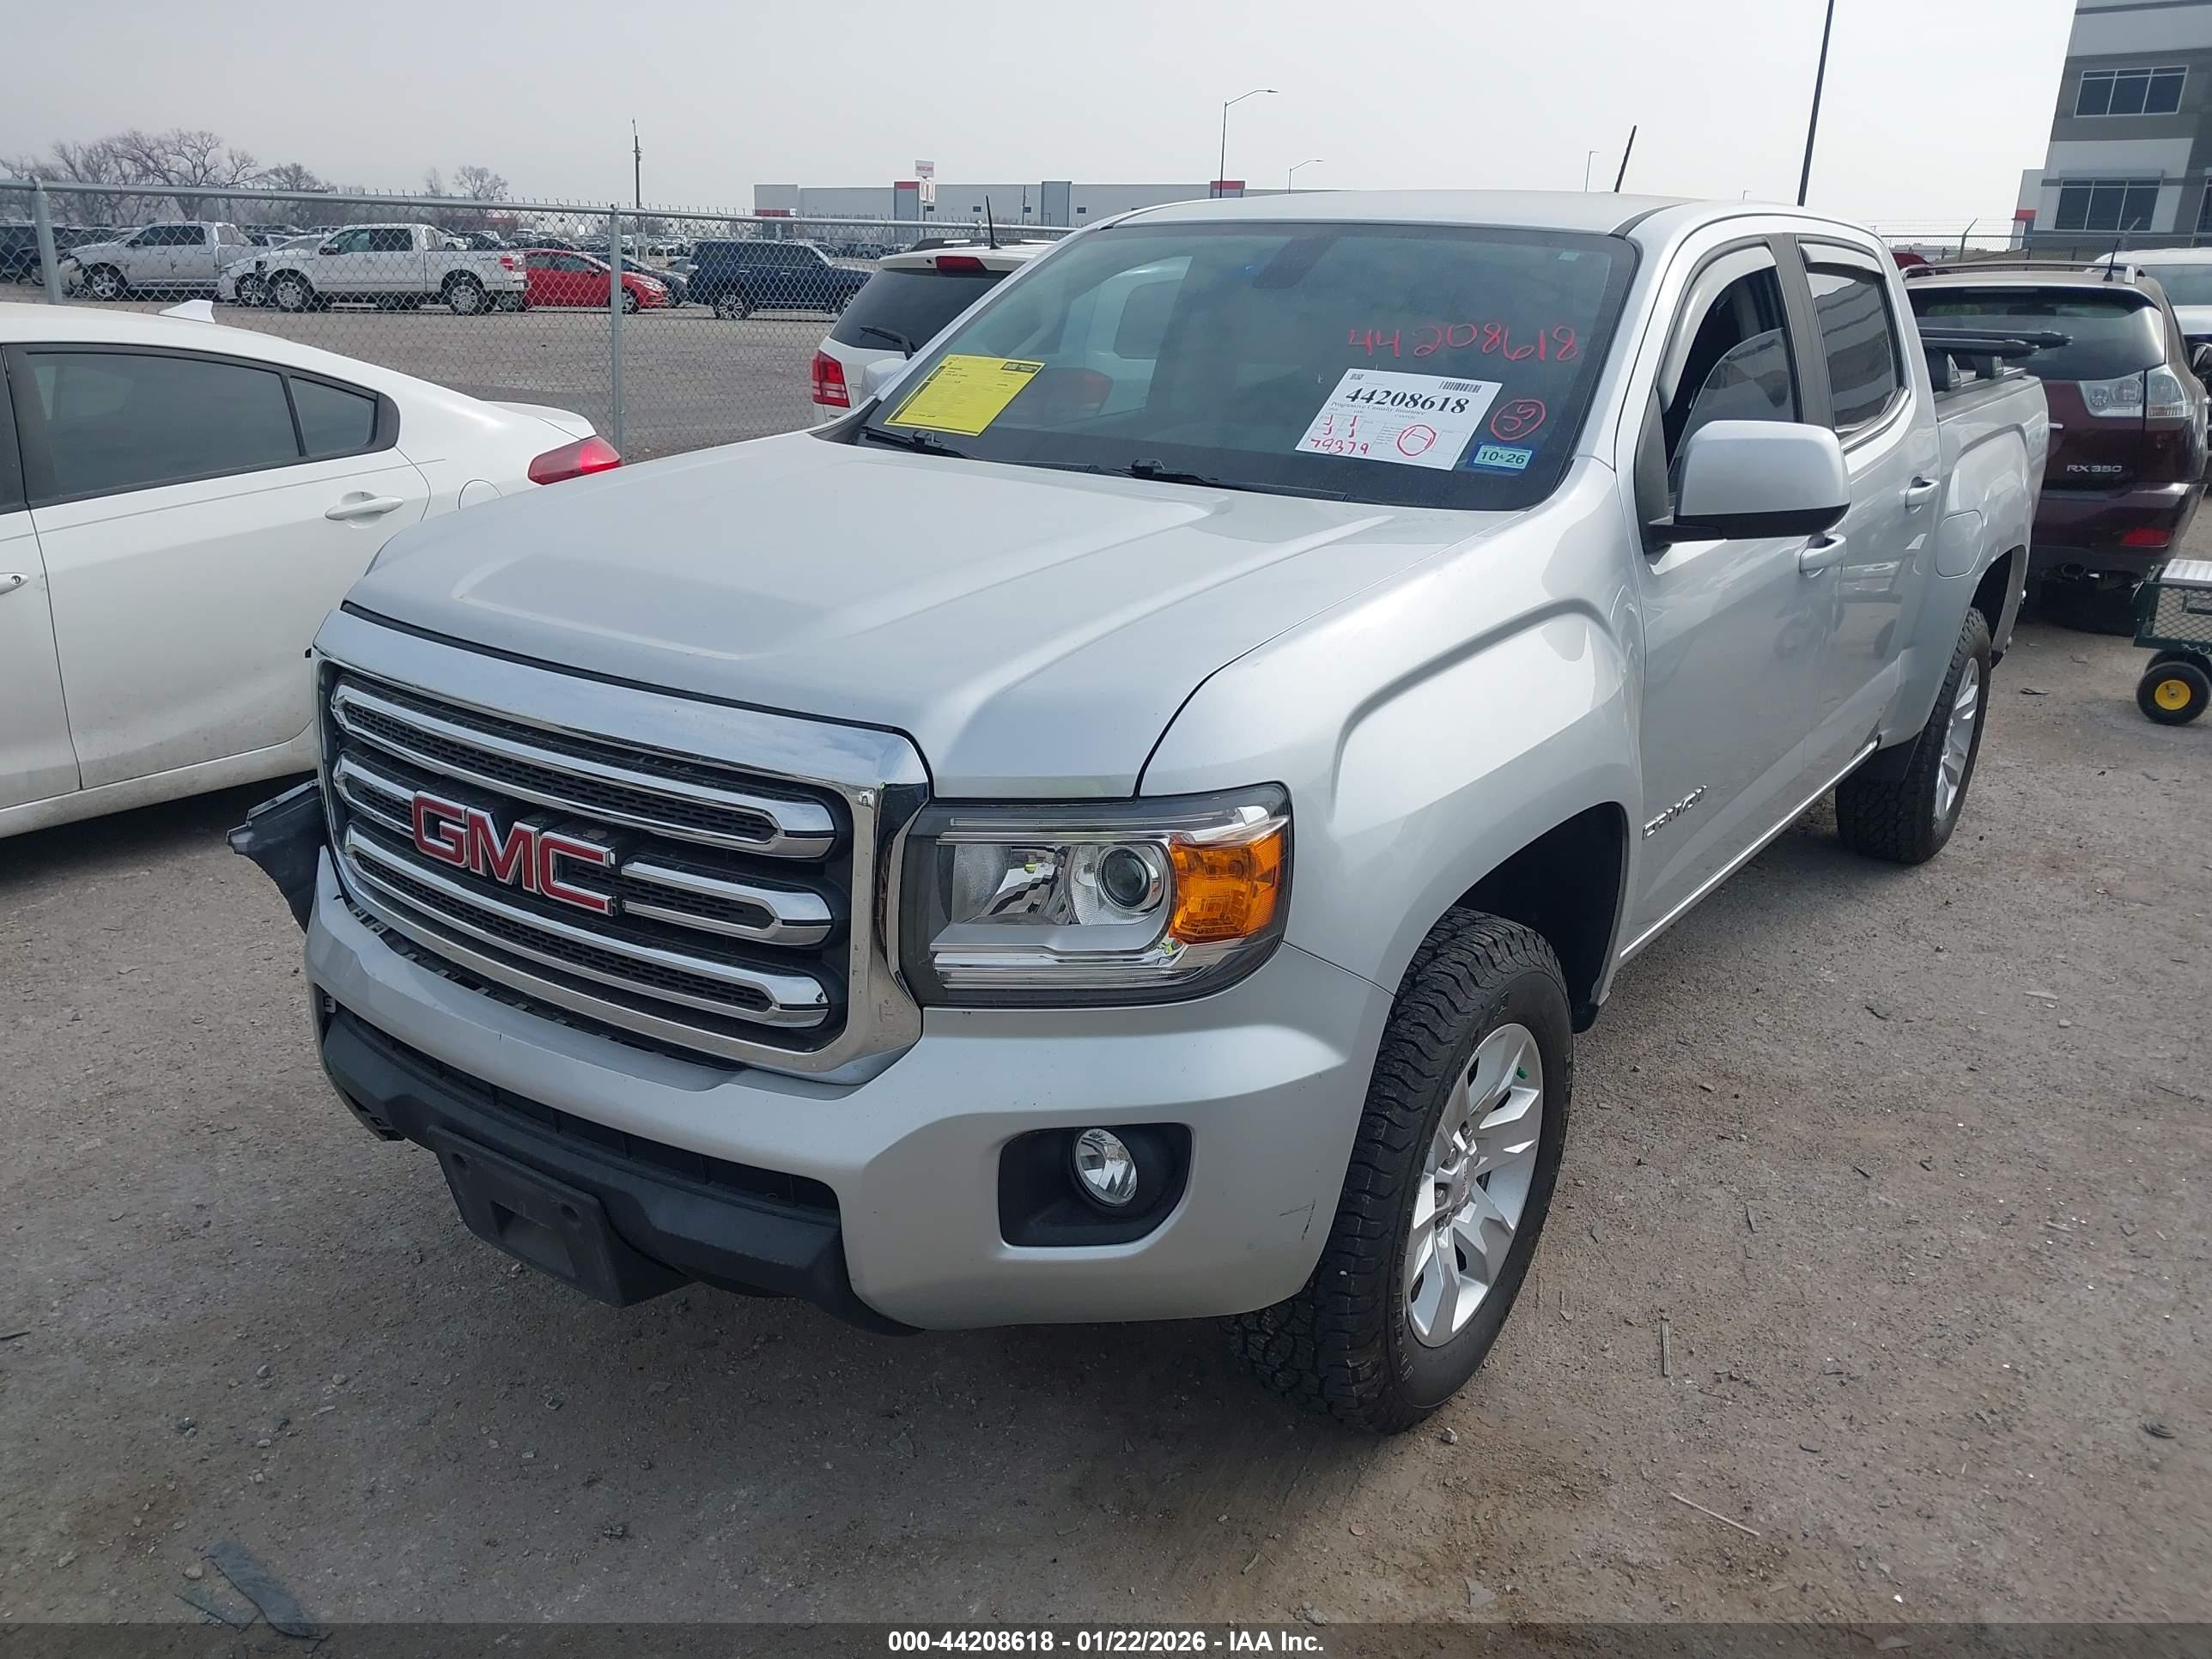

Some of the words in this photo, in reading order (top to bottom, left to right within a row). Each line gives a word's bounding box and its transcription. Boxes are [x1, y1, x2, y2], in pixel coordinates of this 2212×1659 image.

[1331, 401, 1365, 410] Progressive
[1345, 386, 1471, 415] 44208618
[412, 790, 617, 916] GMC
